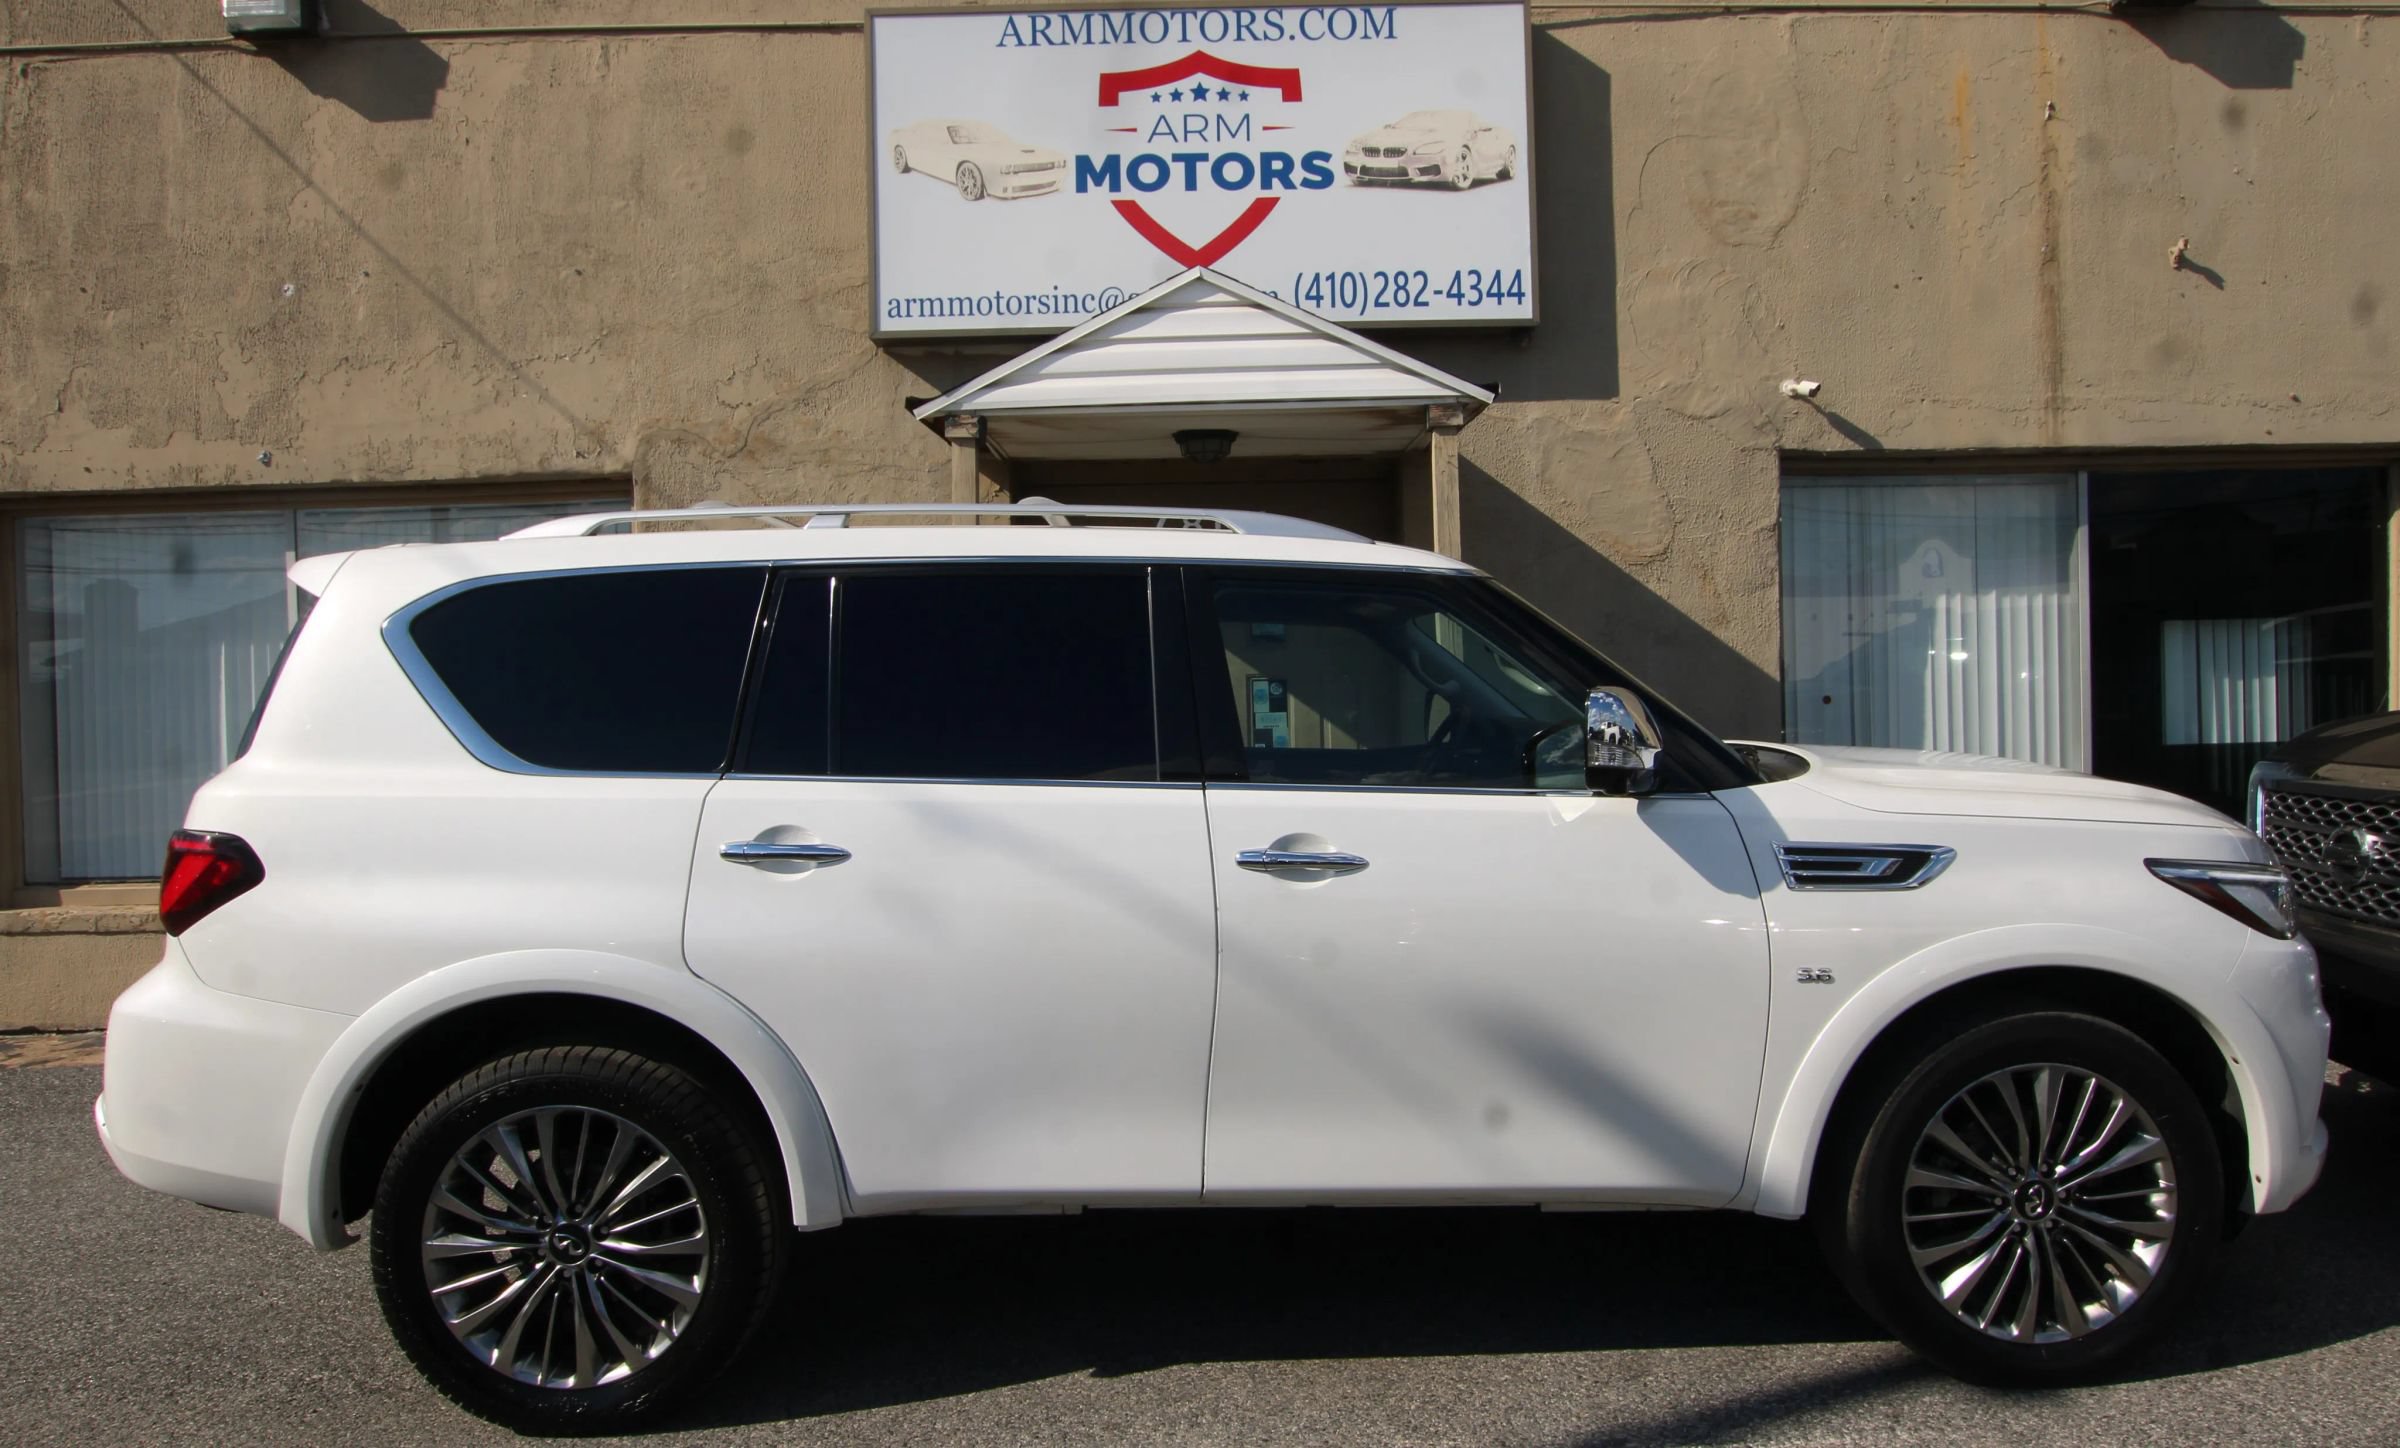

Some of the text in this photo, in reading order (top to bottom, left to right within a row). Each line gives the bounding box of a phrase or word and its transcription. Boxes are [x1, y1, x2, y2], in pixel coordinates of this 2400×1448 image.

[996, 7, 1398, 47] ARMMOTORS.COM
[1147, 112, 1251, 143] ARM
[1075, 150, 1335, 193] MOTORS
[1294, 269, 1526, 316] (410)282-4344
